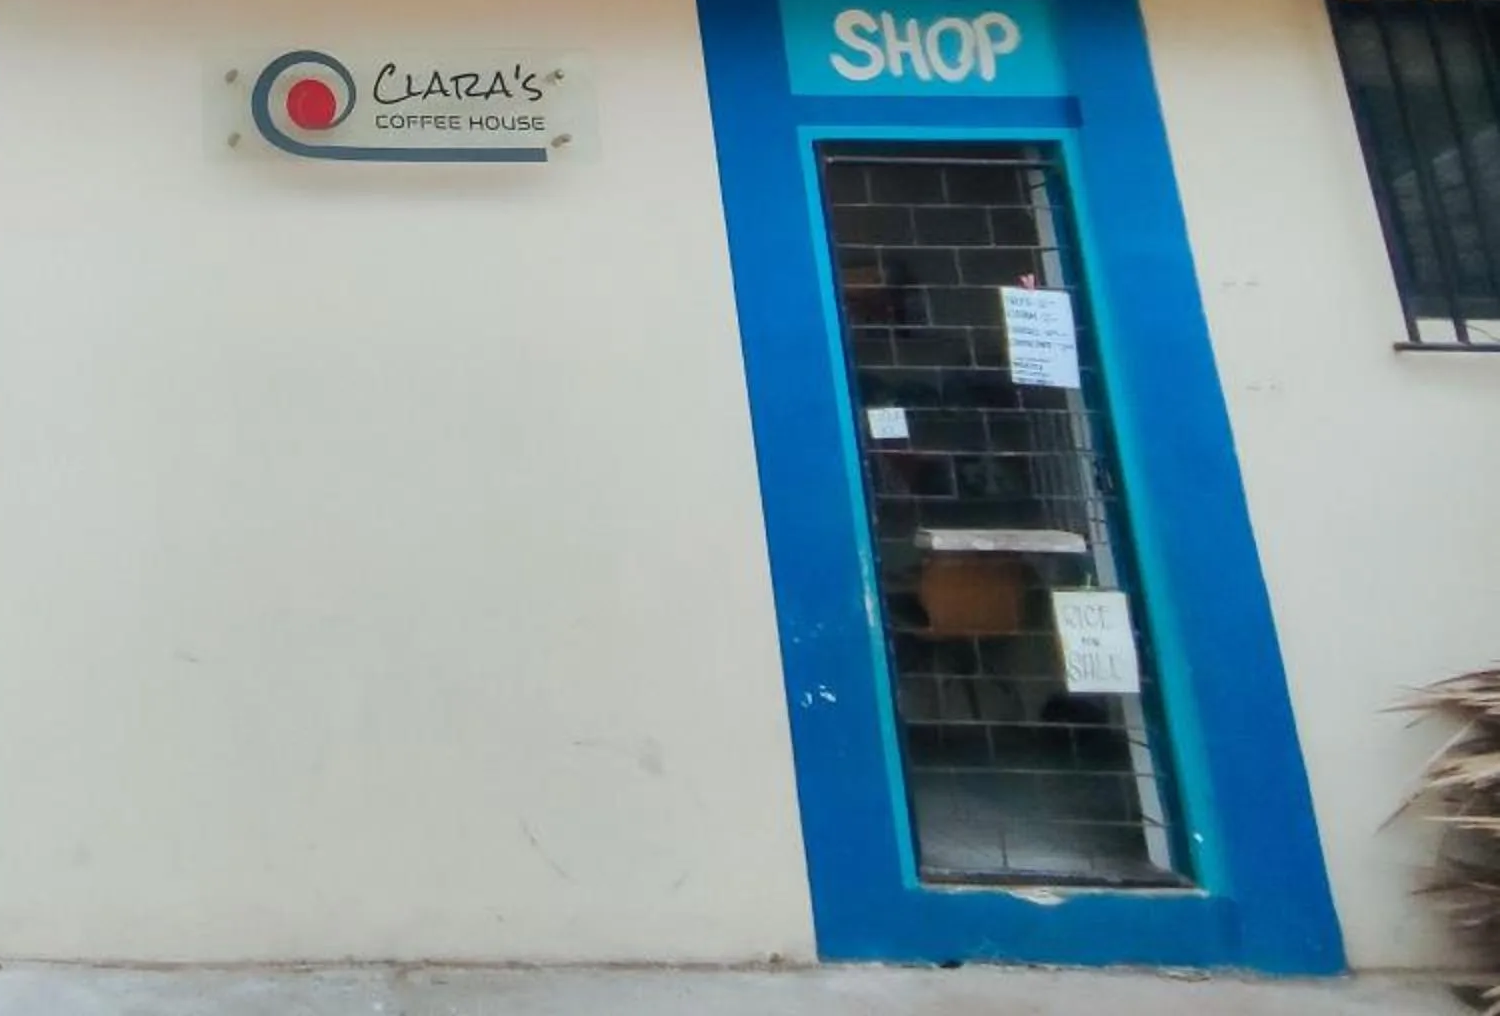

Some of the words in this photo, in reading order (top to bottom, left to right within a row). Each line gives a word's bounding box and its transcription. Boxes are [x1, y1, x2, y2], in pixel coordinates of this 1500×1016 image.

[828, 8, 1023, 83] SHOP
[372, 62, 545, 105] CLARA'S
[375, 115, 462, 132] COFFEE
[469, 115, 546, 132] HOUSE
